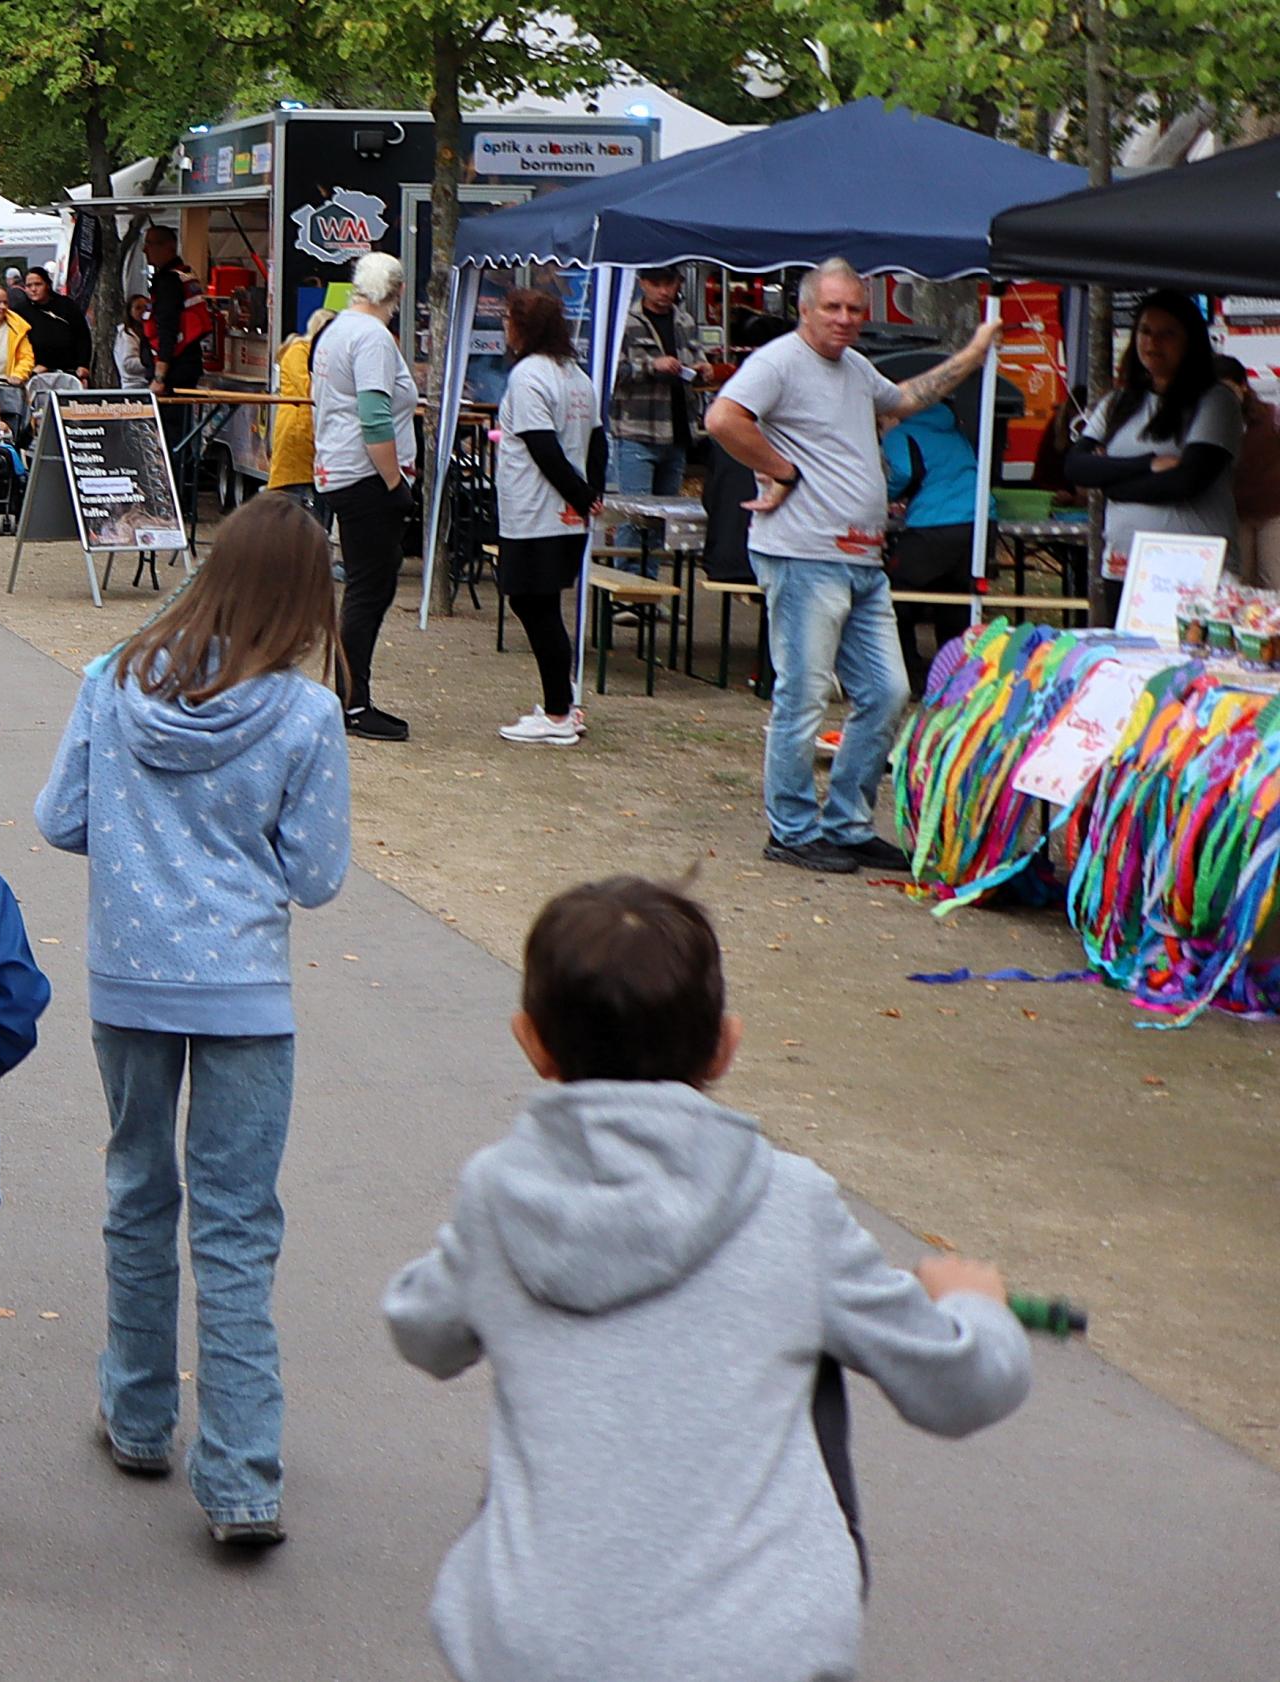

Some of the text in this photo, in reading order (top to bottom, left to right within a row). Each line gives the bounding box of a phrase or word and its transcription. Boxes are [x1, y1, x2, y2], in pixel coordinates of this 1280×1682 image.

[482, 140, 520, 156] optik
[598, 142, 634, 156] haus
[520, 158, 595, 172] bormann
[316, 216, 372, 242] WM
